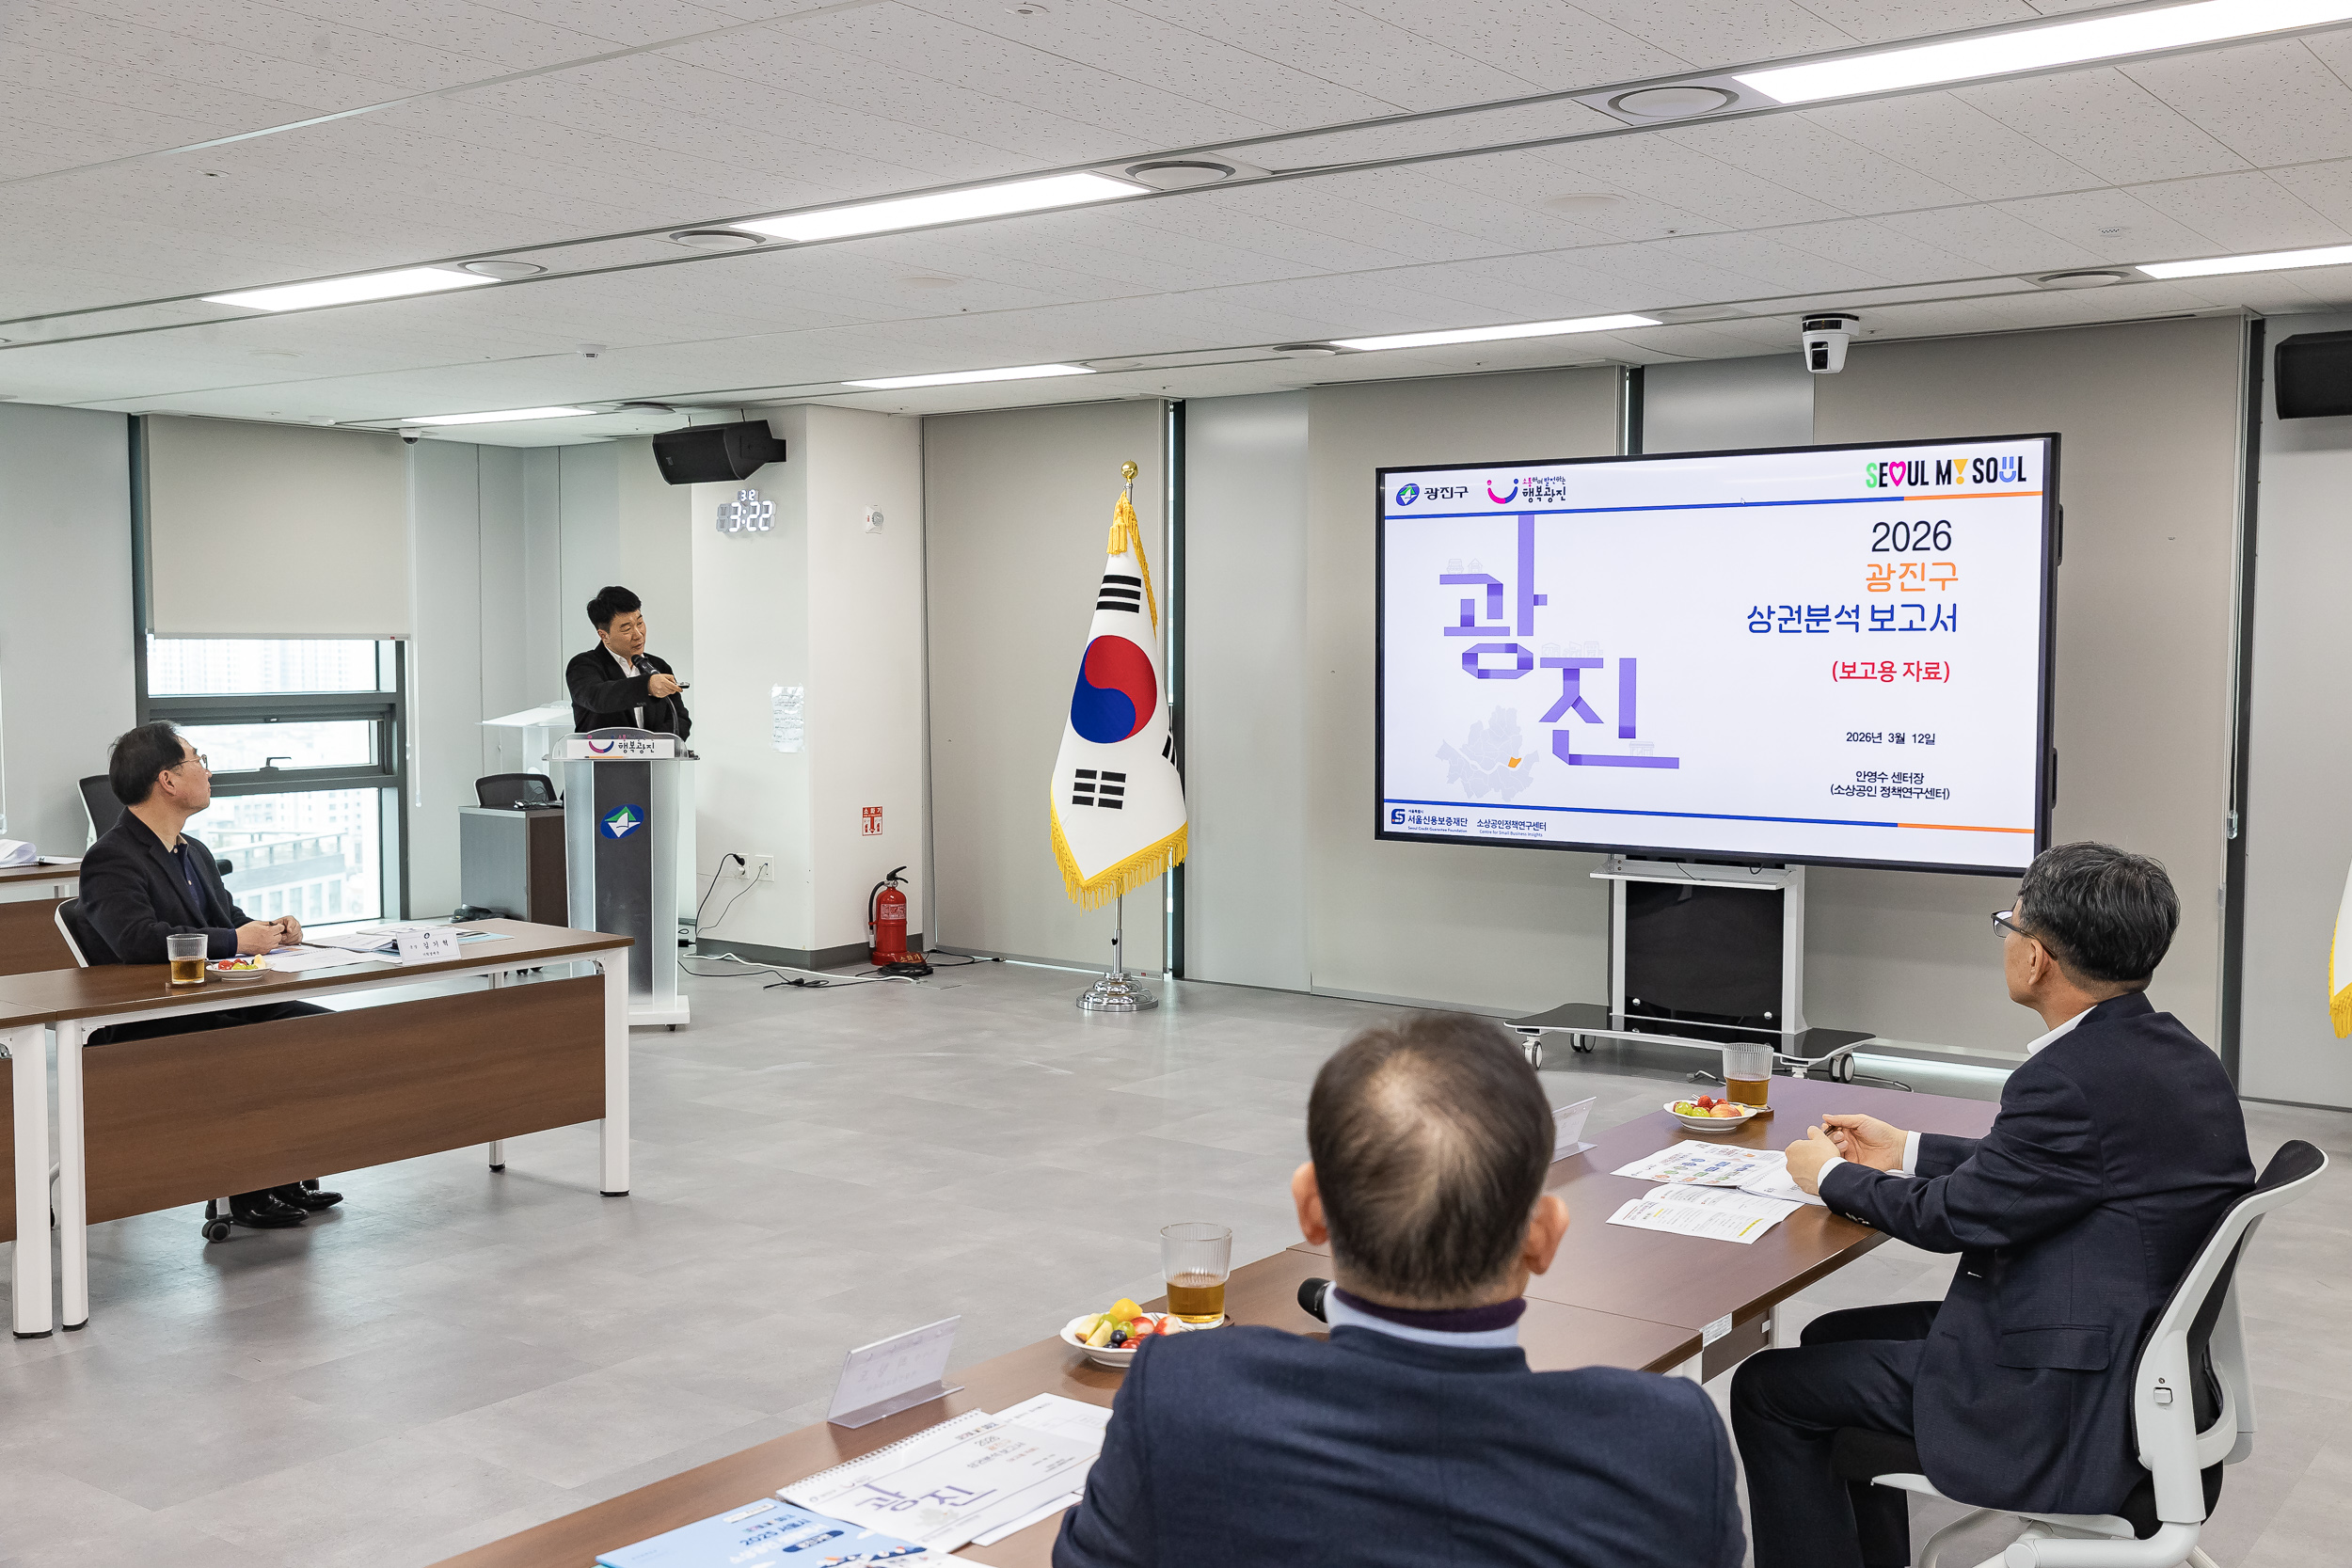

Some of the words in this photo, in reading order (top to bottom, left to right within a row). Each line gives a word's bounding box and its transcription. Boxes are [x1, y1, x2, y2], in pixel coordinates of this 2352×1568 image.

[1972, 455, 2027, 483] SOUL
[1423, 485, 1470, 500] 광진구
[1521, 485, 1566, 503] 행복광진
[729, 500, 773, 532] 3:22
[1870, 519, 1953, 553] 2026
[1866, 562, 1959, 593] 광진구
[1746, 604, 1860, 634] 상권분석
[1867, 603, 1959, 633] 보고서
[1832, 660, 1898, 683] (보고용
[1902, 659, 1951, 684] 자료)
[617, 740, 655, 753] 행복광진
[1846, 732, 1883, 744] 2026년
[1887, 732, 1906, 744] 3월
[1912, 733, 1936, 745] 12일
[1855, 770, 1889, 784] 안영수
[1890, 771, 1925, 784] 센터장
[1830, 784, 1878, 798] (소상공인
[1880, 784, 1950, 800] 정책연구센터)
[1407, 815, 1468, 828] 서울신용보증재단
[1476, 818, 1547, 832] 소상공인정책연구센터
